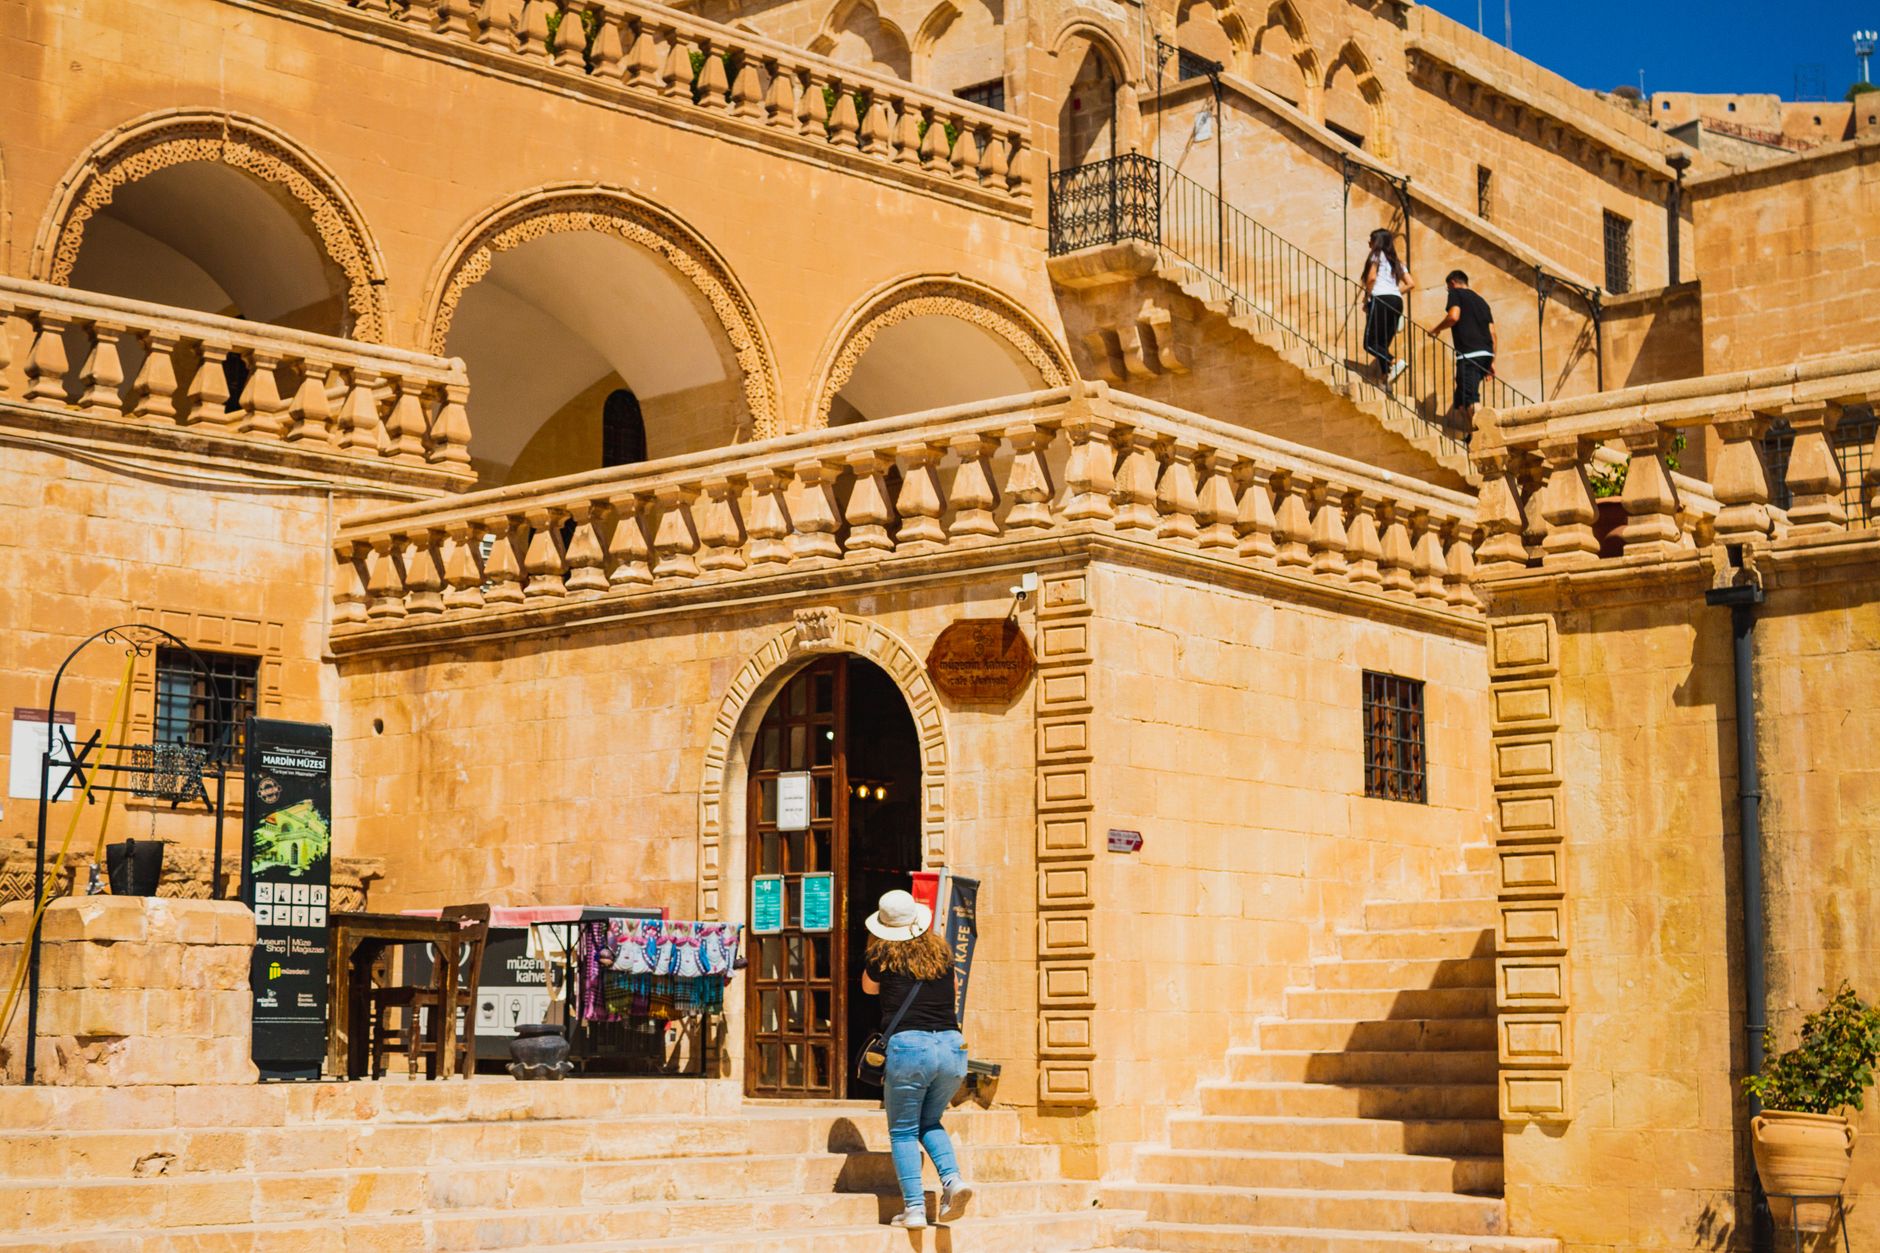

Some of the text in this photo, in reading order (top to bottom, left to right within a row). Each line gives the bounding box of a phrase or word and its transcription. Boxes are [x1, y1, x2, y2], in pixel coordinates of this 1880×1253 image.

[262, 755, 326, 769] MARDİN MÜZESİ
[291, 938, 312, 947] Müze
[954, 925, 971, 964] KAFE
[266, 945, 286, 953] Shop
[516, 970, 555, 982] kahvei
